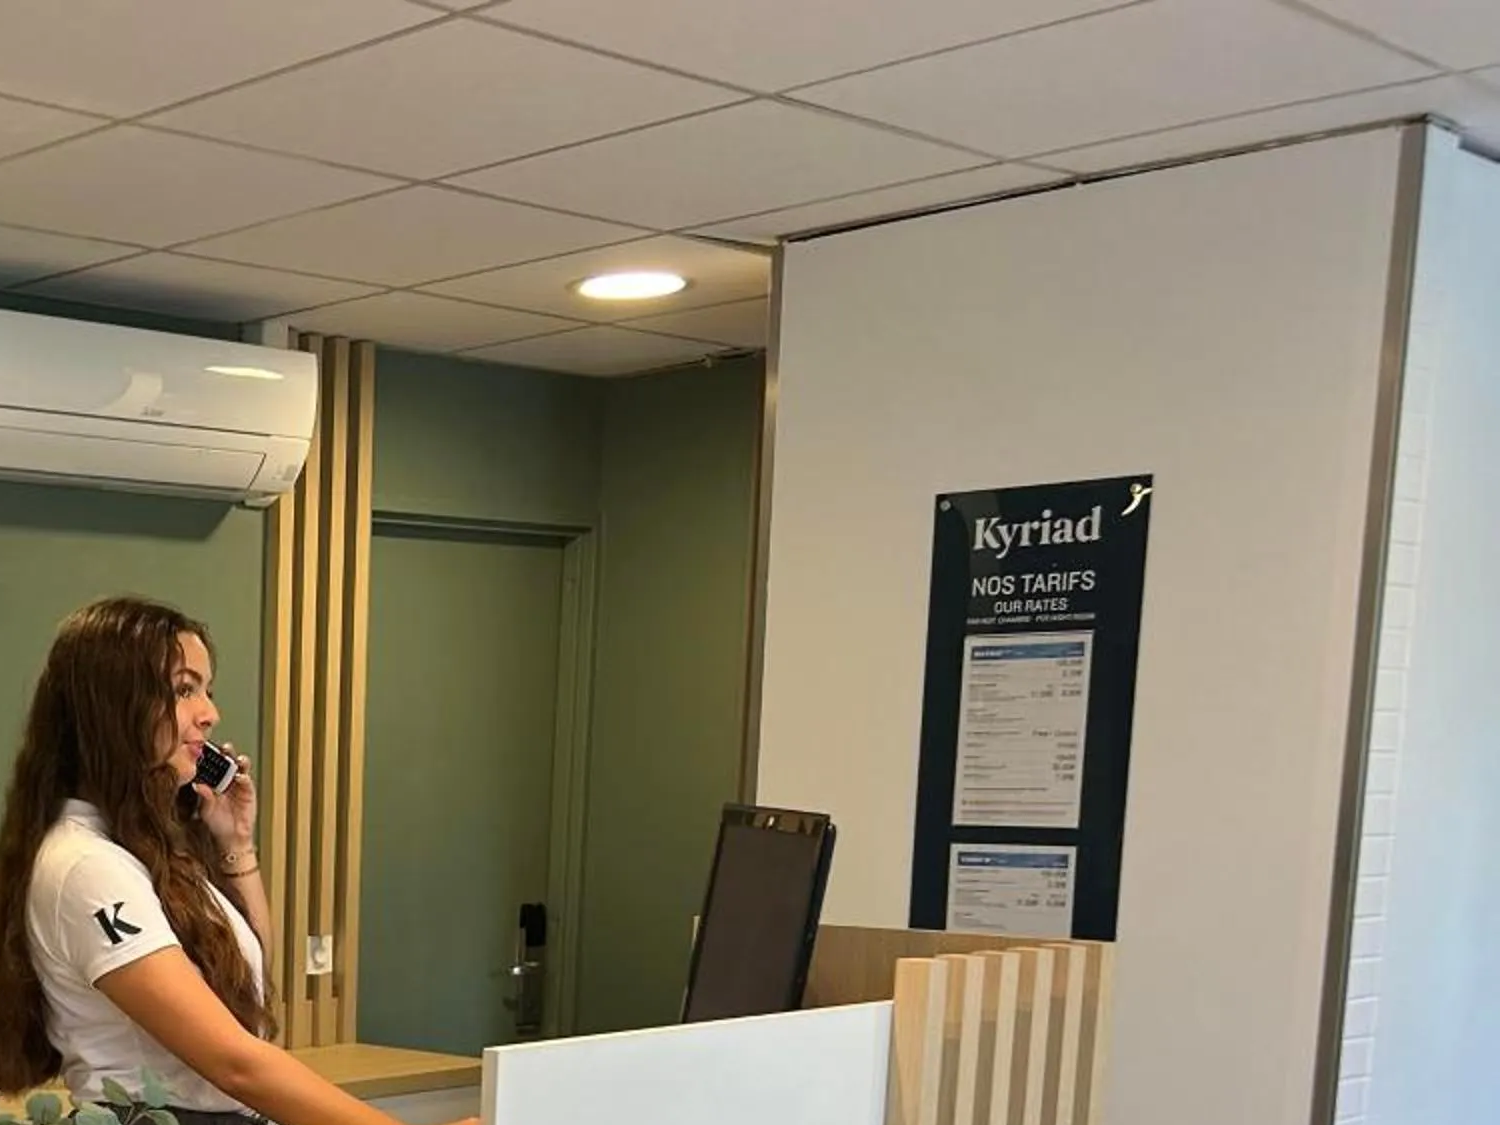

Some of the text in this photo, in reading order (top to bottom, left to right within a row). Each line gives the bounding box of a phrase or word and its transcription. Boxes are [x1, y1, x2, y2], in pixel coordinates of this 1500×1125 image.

[973, 505, 1102, 559] Kyriad
[971, 570, 1096, 597] NOS TARIFS
[994, 598, 1068, 614] OUR RATES
[93, 901, 142, 945] K
